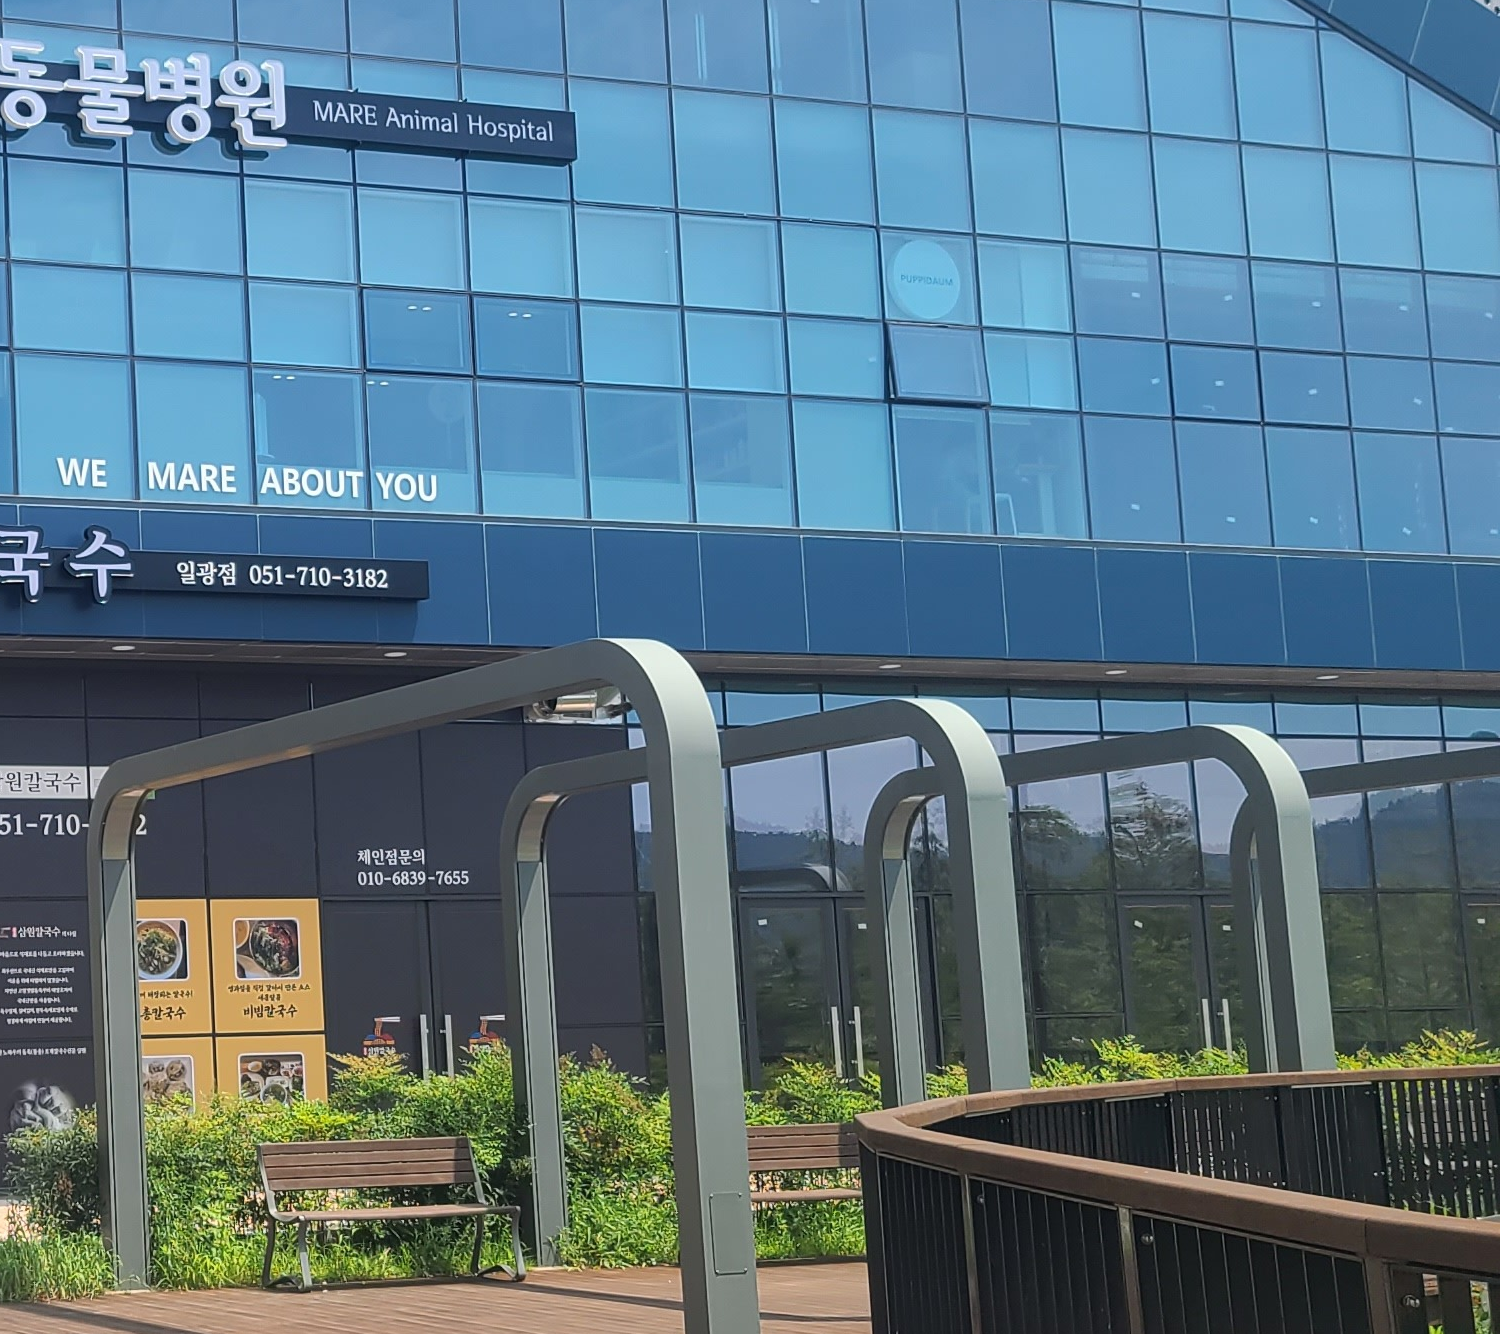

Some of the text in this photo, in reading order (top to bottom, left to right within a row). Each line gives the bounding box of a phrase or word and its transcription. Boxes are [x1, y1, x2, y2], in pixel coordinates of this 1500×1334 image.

[312, 100, 378, 126] MARE
[385, 107, 458, 134] Animal
[467, 114, 554, 143] Hospital
[56, 457, 108, 487] WE
[148, 461, 237, 493] MARE
[260, 467, 363, 498] ABOUT
[375, 471, 437, 501] YOU
[176, 560, 237, 586] 일광점
[249, 565, 389, 589] 051-710-3182
[357, 849, 426, 866] 체인점문의
[140, 1006, 187, 1021] 총칼국수
[243, 1004, 298, 1019] 비빔칼국수
